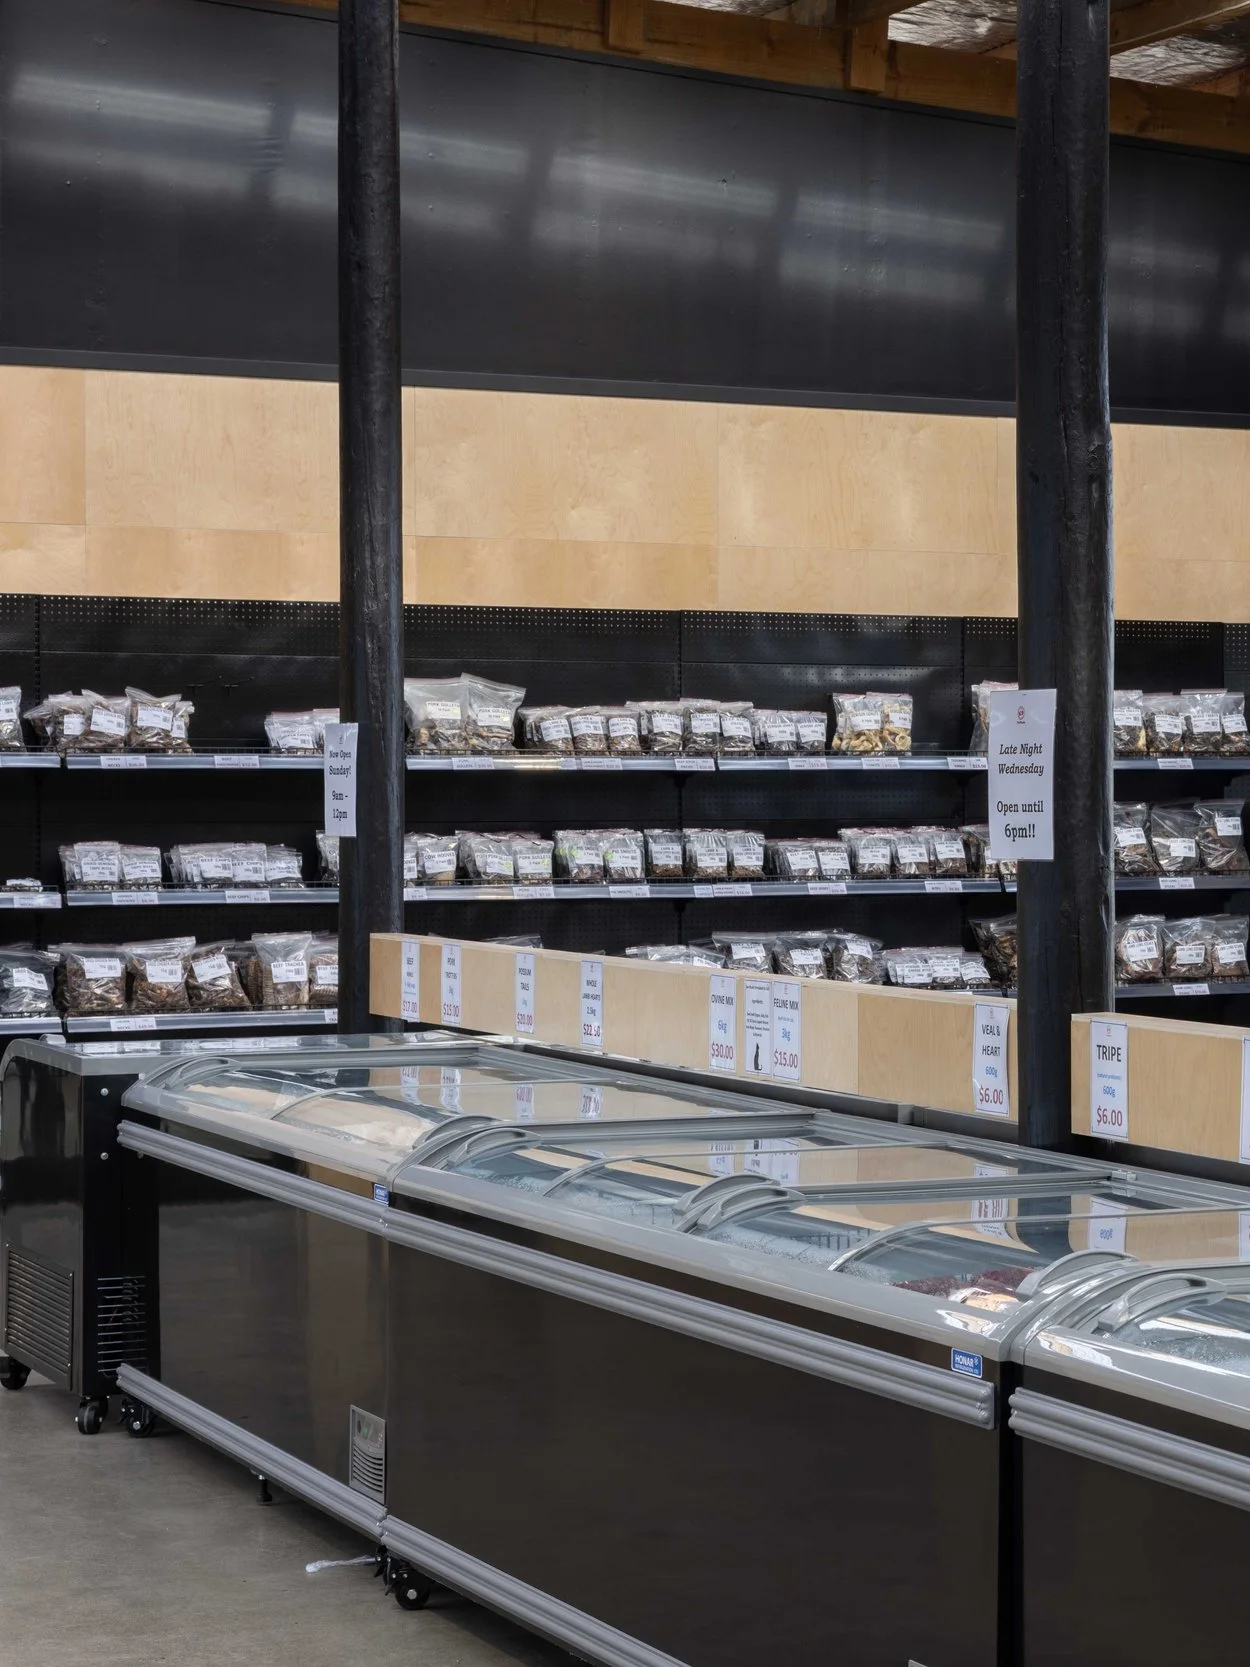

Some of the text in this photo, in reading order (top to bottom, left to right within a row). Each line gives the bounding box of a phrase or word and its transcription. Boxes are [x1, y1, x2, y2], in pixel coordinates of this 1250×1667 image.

[329, 750, 351, 760] Now Open
[999, 743, 1042, 757] Late Night
[329, 765, 351, 778] Sunday!
[998, 763, 1044, 776] Wednesday
[332, 790, 343, 801] 9am
[996, 800, 1044, 816] Open until
[333, 809, 347, 821] 12pm
[1004, 823, 1035, 842] 6pm!!
[518, 968, 532, 976] POSSUM
[520, 982, 529, 991] TAILS
[712, 994, 734, 1006] OVINE MIX
[774, 998, 799, 1011] FELINE MIX
[517, 1012, 532, 1026] $20.00
[583, 1024, 600, 1037] $22.50
[718, 1019, 727, 1034] 6kg
[982, 1023, 1000, 1036] VEAL &
[711, 1041, 734, 1060] $30.00
[982, 1045, 1000, 1056] HEART
[1096, 1044, 1122, 1062] TRIPE
[774, 1048, 798, 1069] $15.00
[985, 1066, 997, 1078] 600g
[979, 1084, 1003, 1105] $6.00
[1103, 1085, 1116, 1098] 600g
[1096, 1105, 1123, 1127] $6.00
[955, 1353, 973, 1367] HONAR
